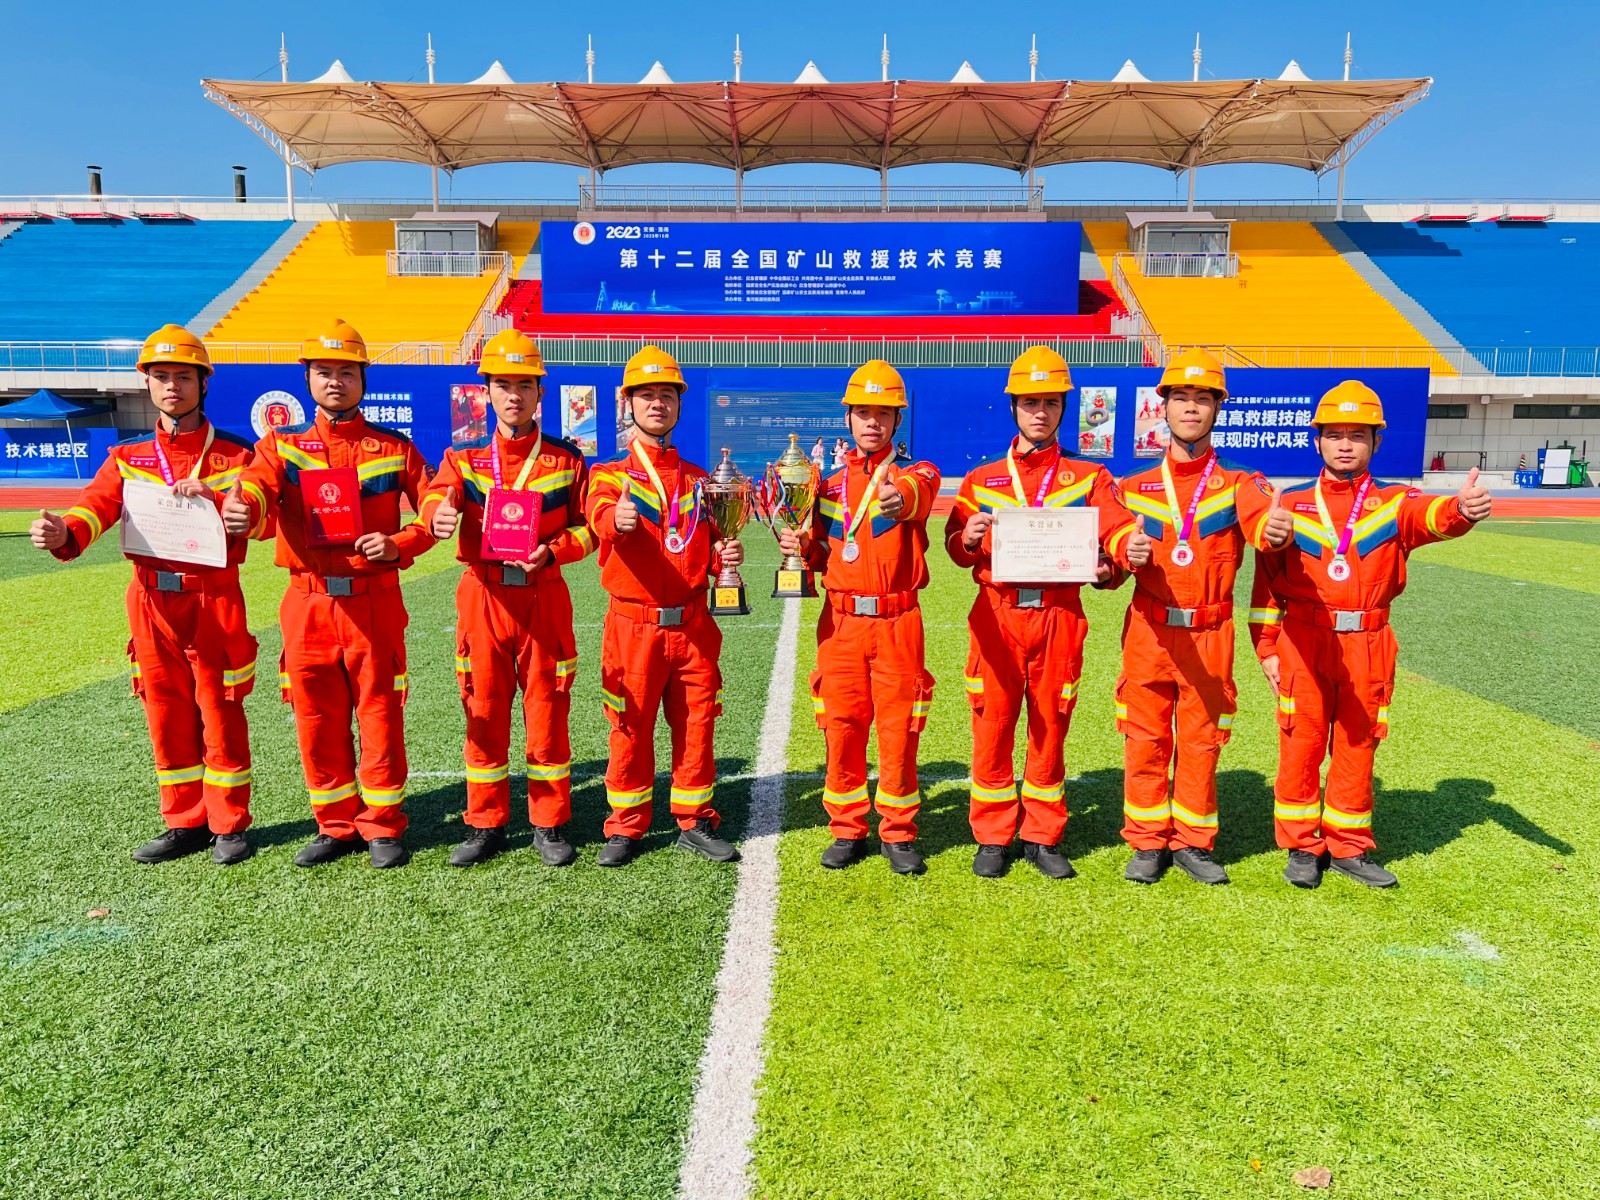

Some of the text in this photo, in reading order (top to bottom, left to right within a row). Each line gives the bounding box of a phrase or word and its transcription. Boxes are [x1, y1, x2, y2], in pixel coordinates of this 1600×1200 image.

[606, 226, 641, 239] 2023
[619, 248, 1004, 269] 第十二届全国矿山救援技术竞赛
[1210, 431, 1309, 448] 展现时代风采
[5, 442, 88, 458] 技术操控区
